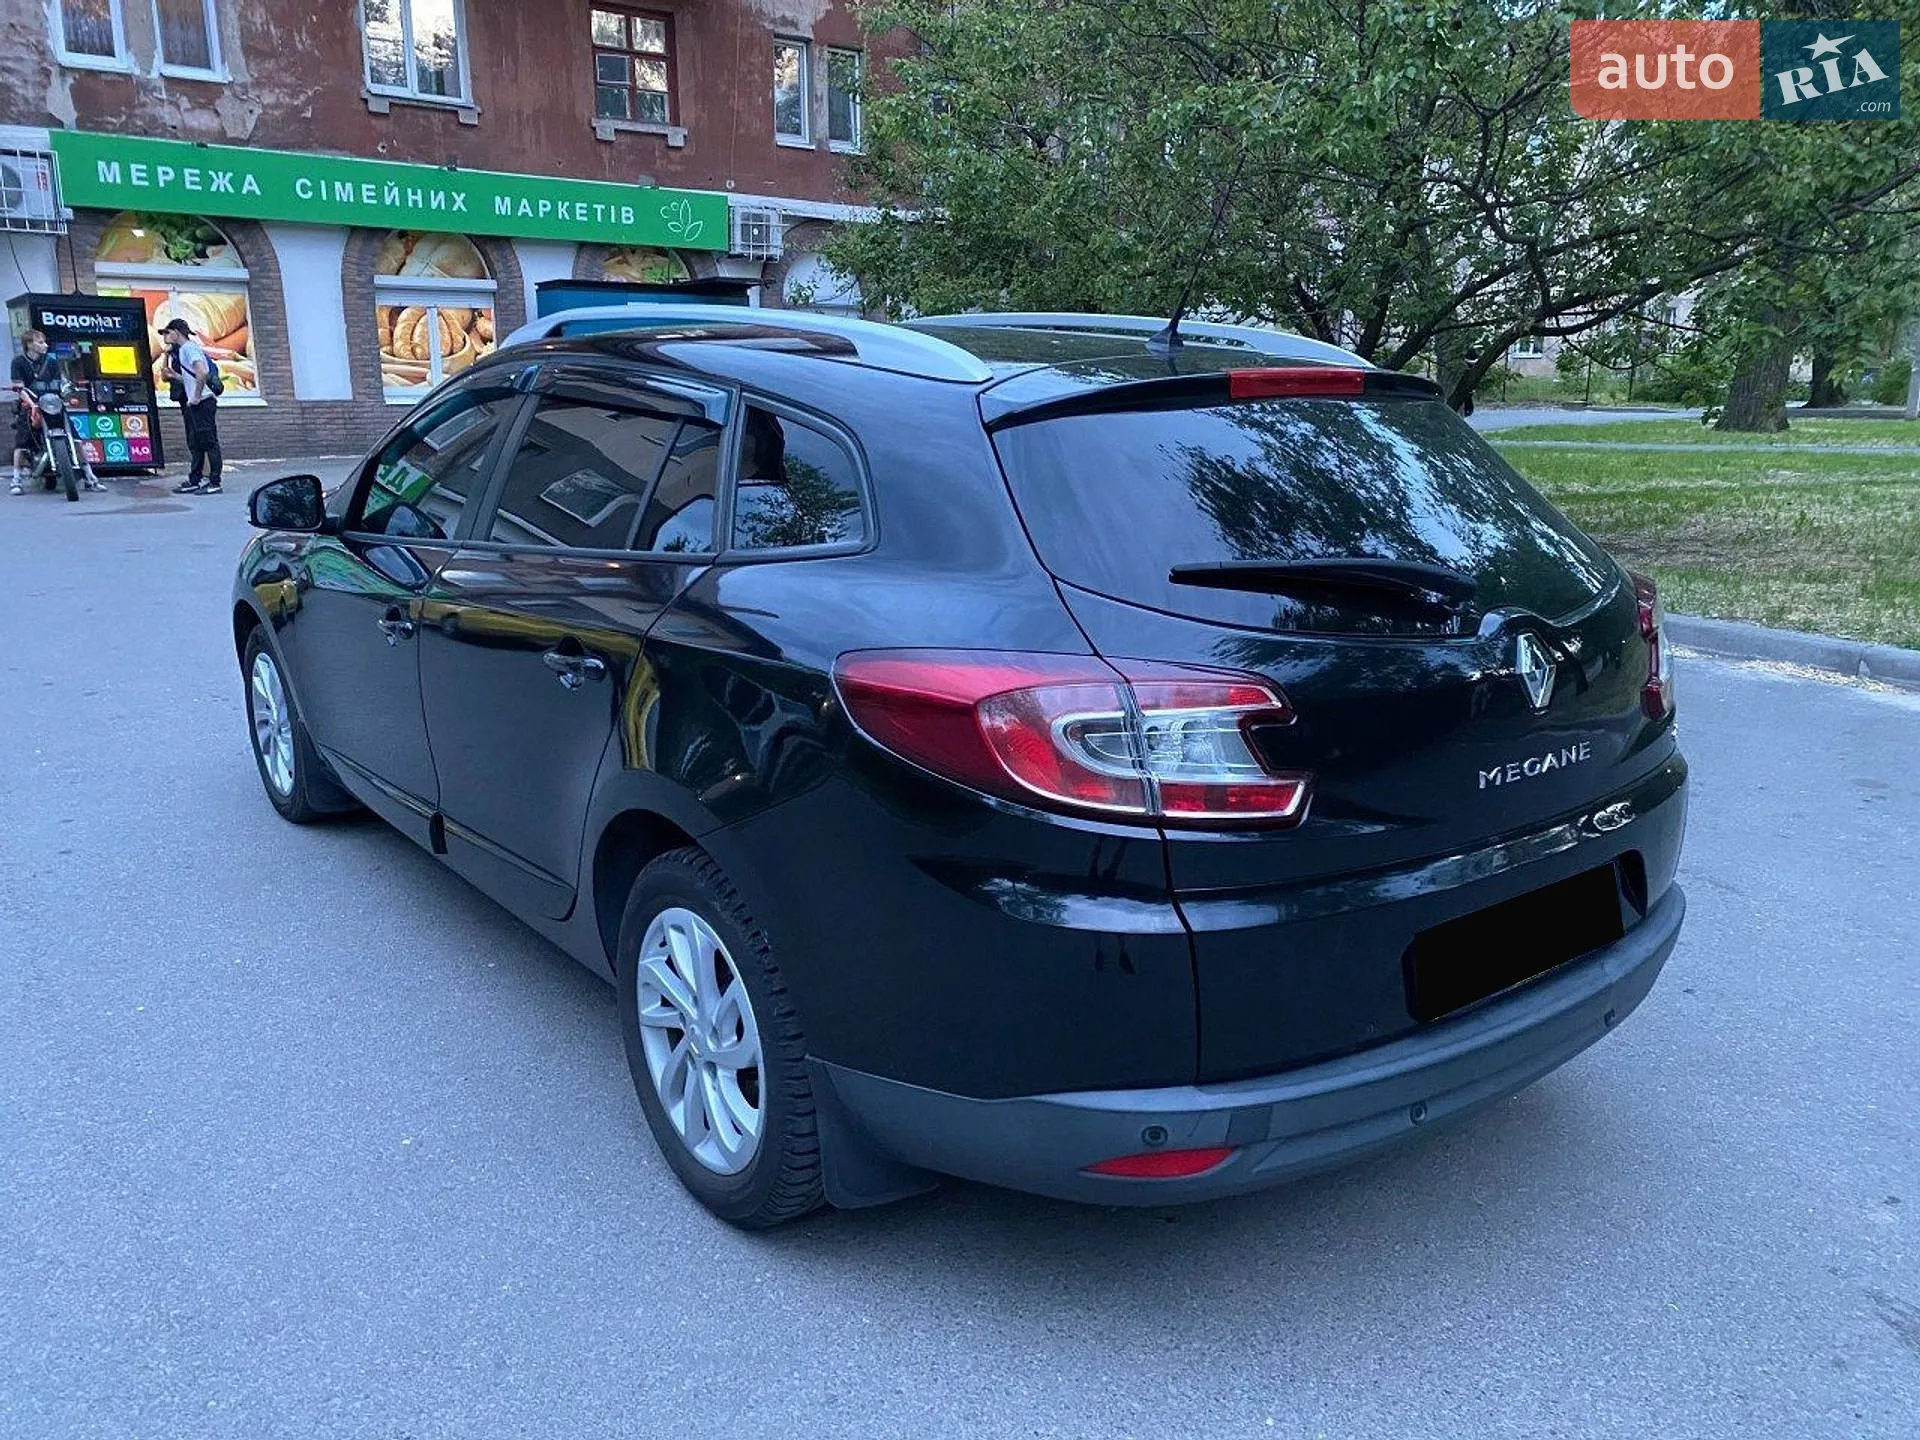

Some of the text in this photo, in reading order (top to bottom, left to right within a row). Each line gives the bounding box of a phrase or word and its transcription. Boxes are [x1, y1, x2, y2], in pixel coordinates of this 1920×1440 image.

[97, 160, 636, 225] МЕРЕЖА СІМЕЙНИХ МАРКЕТІВ
[1478, 741, 1591, 789] MEGANE
